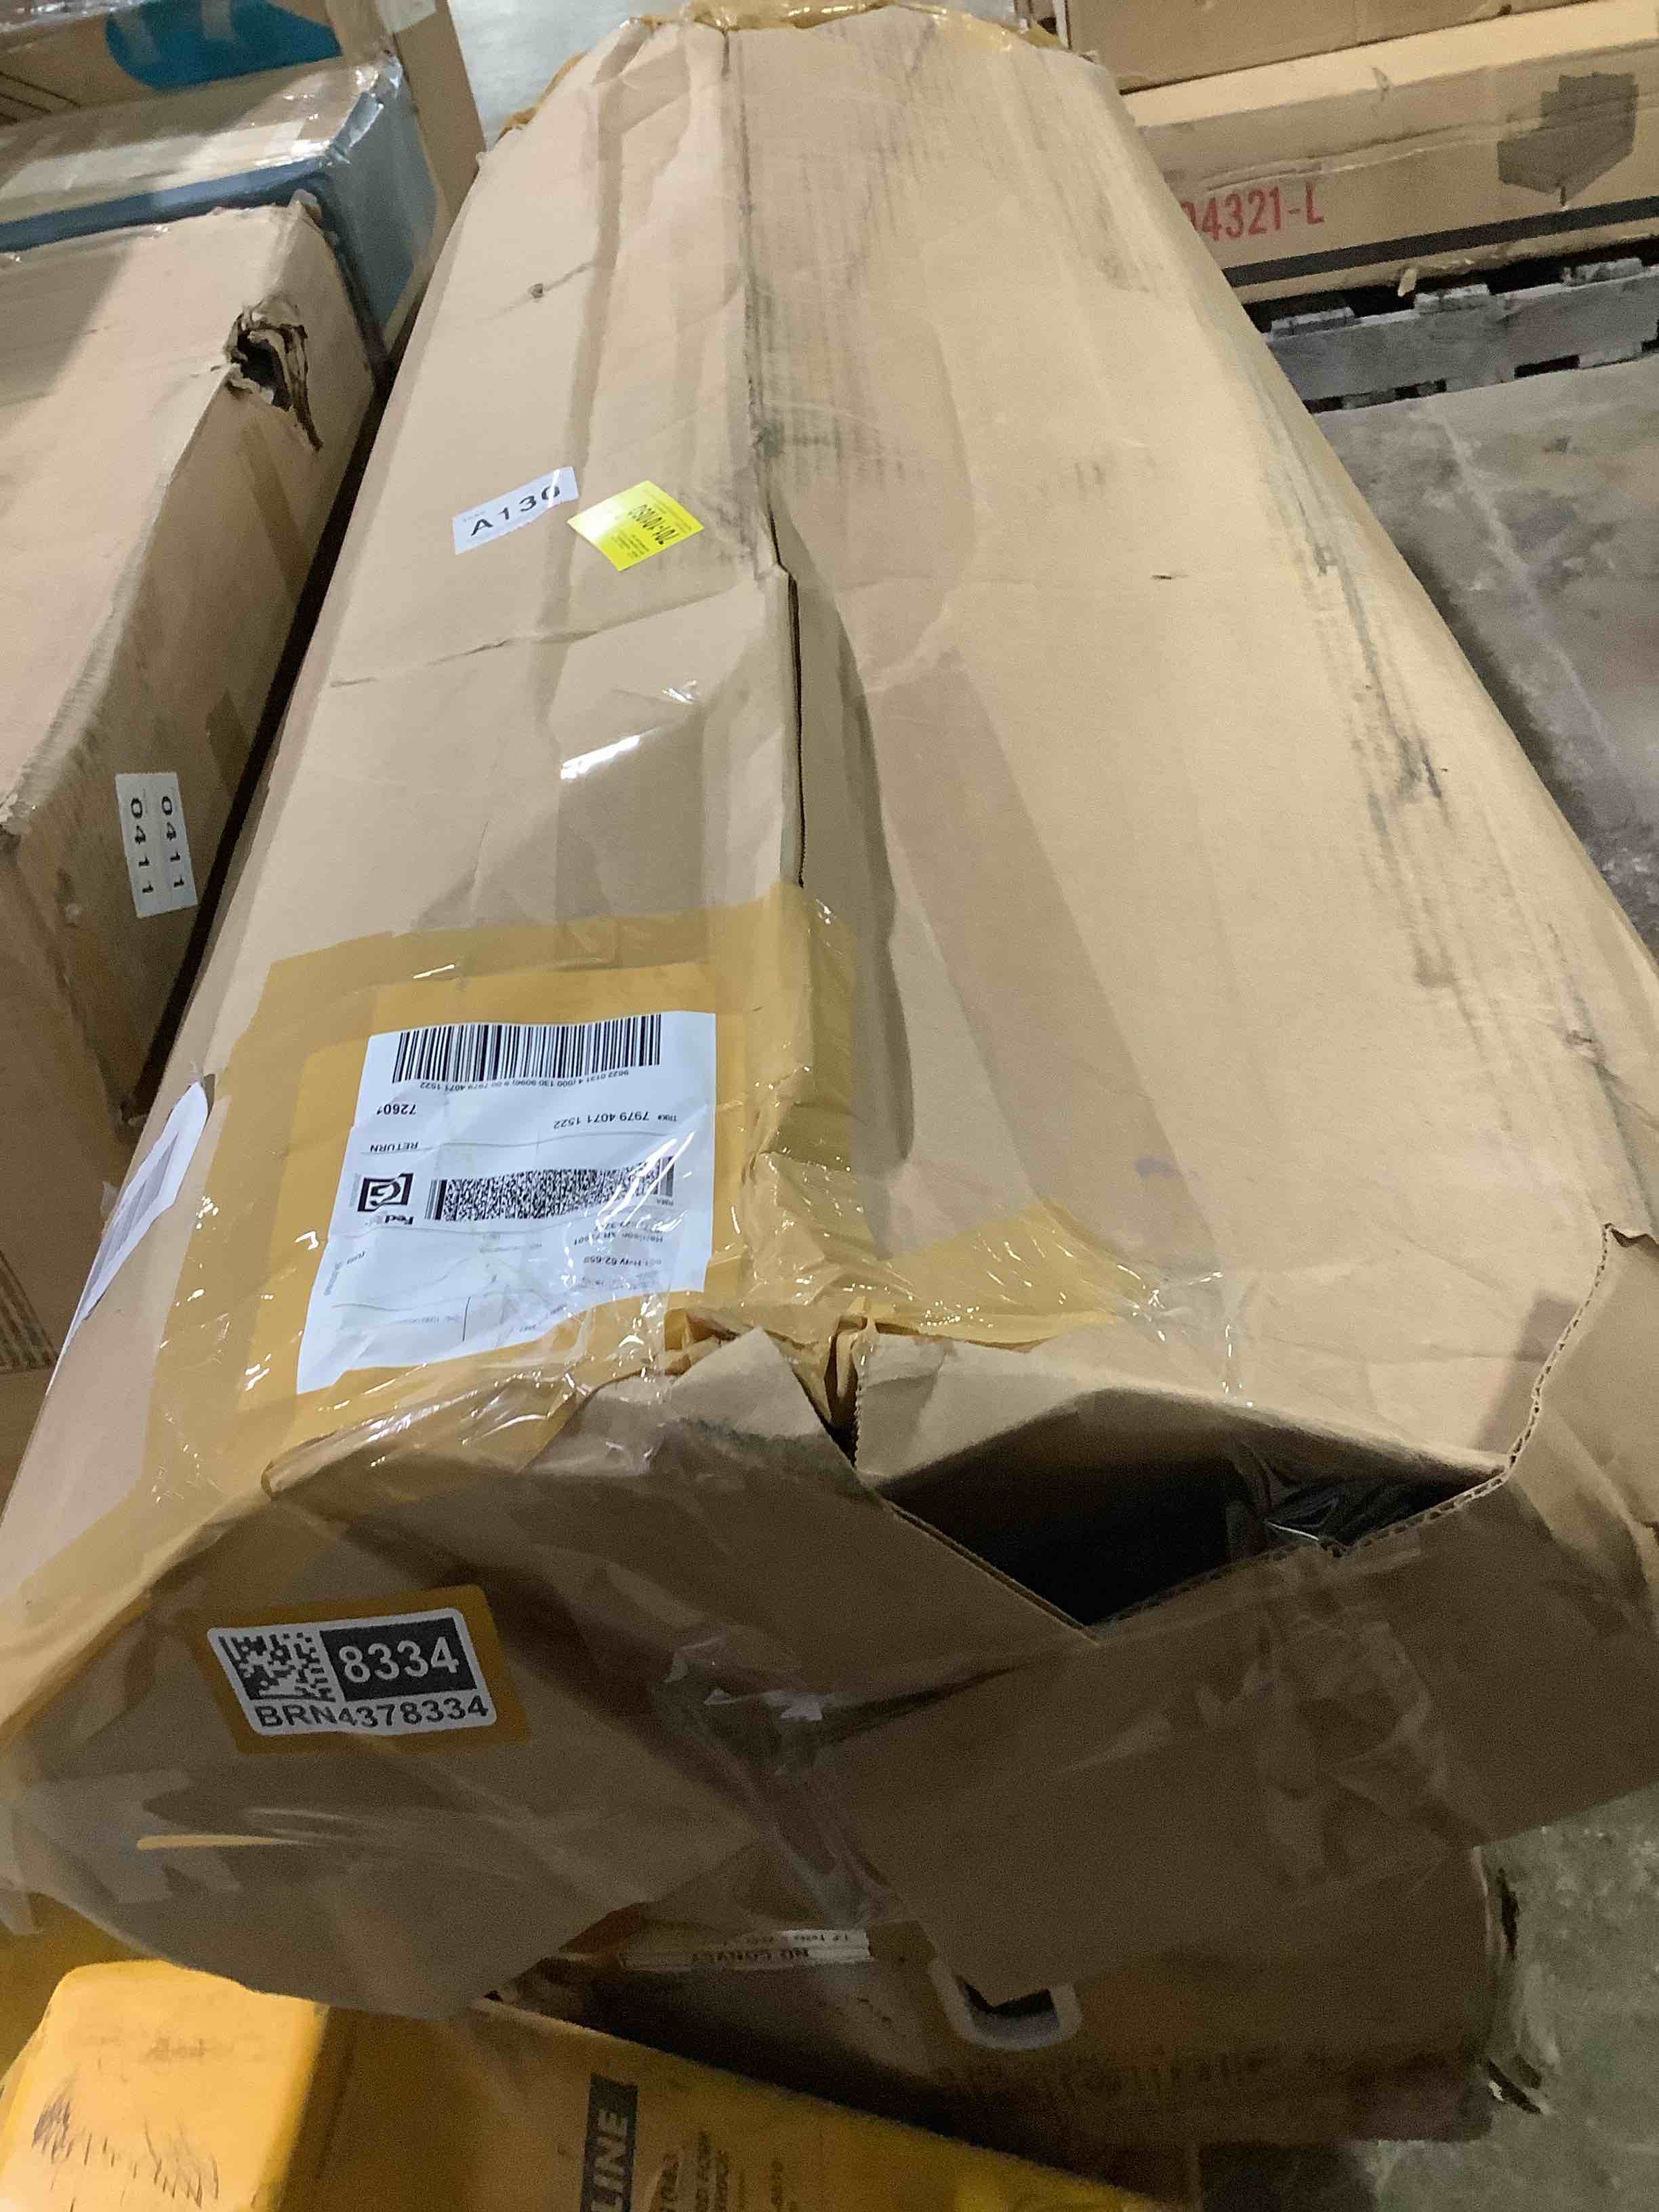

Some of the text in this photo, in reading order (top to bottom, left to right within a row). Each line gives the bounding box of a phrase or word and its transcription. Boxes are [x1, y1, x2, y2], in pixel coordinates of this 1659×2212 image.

[470, 485, 560, 536] A130
[131, 798, 154, 894] 0411
[161, 796, 185, 888] 0411
[445, 1084, 464, 1092] 4071
[377, 1103, 417, 1115] 72601
[553, 1116, 581, 1130] 1522
[587, 1112, 615, 1124] 4071
[619, 1111, 649, 1122] 7979
[370, 1141, 418, 1153] RETURN
[339, 1637, 459, 1683] 8334
[254, 1695, 489, 1728] BRN4378334
